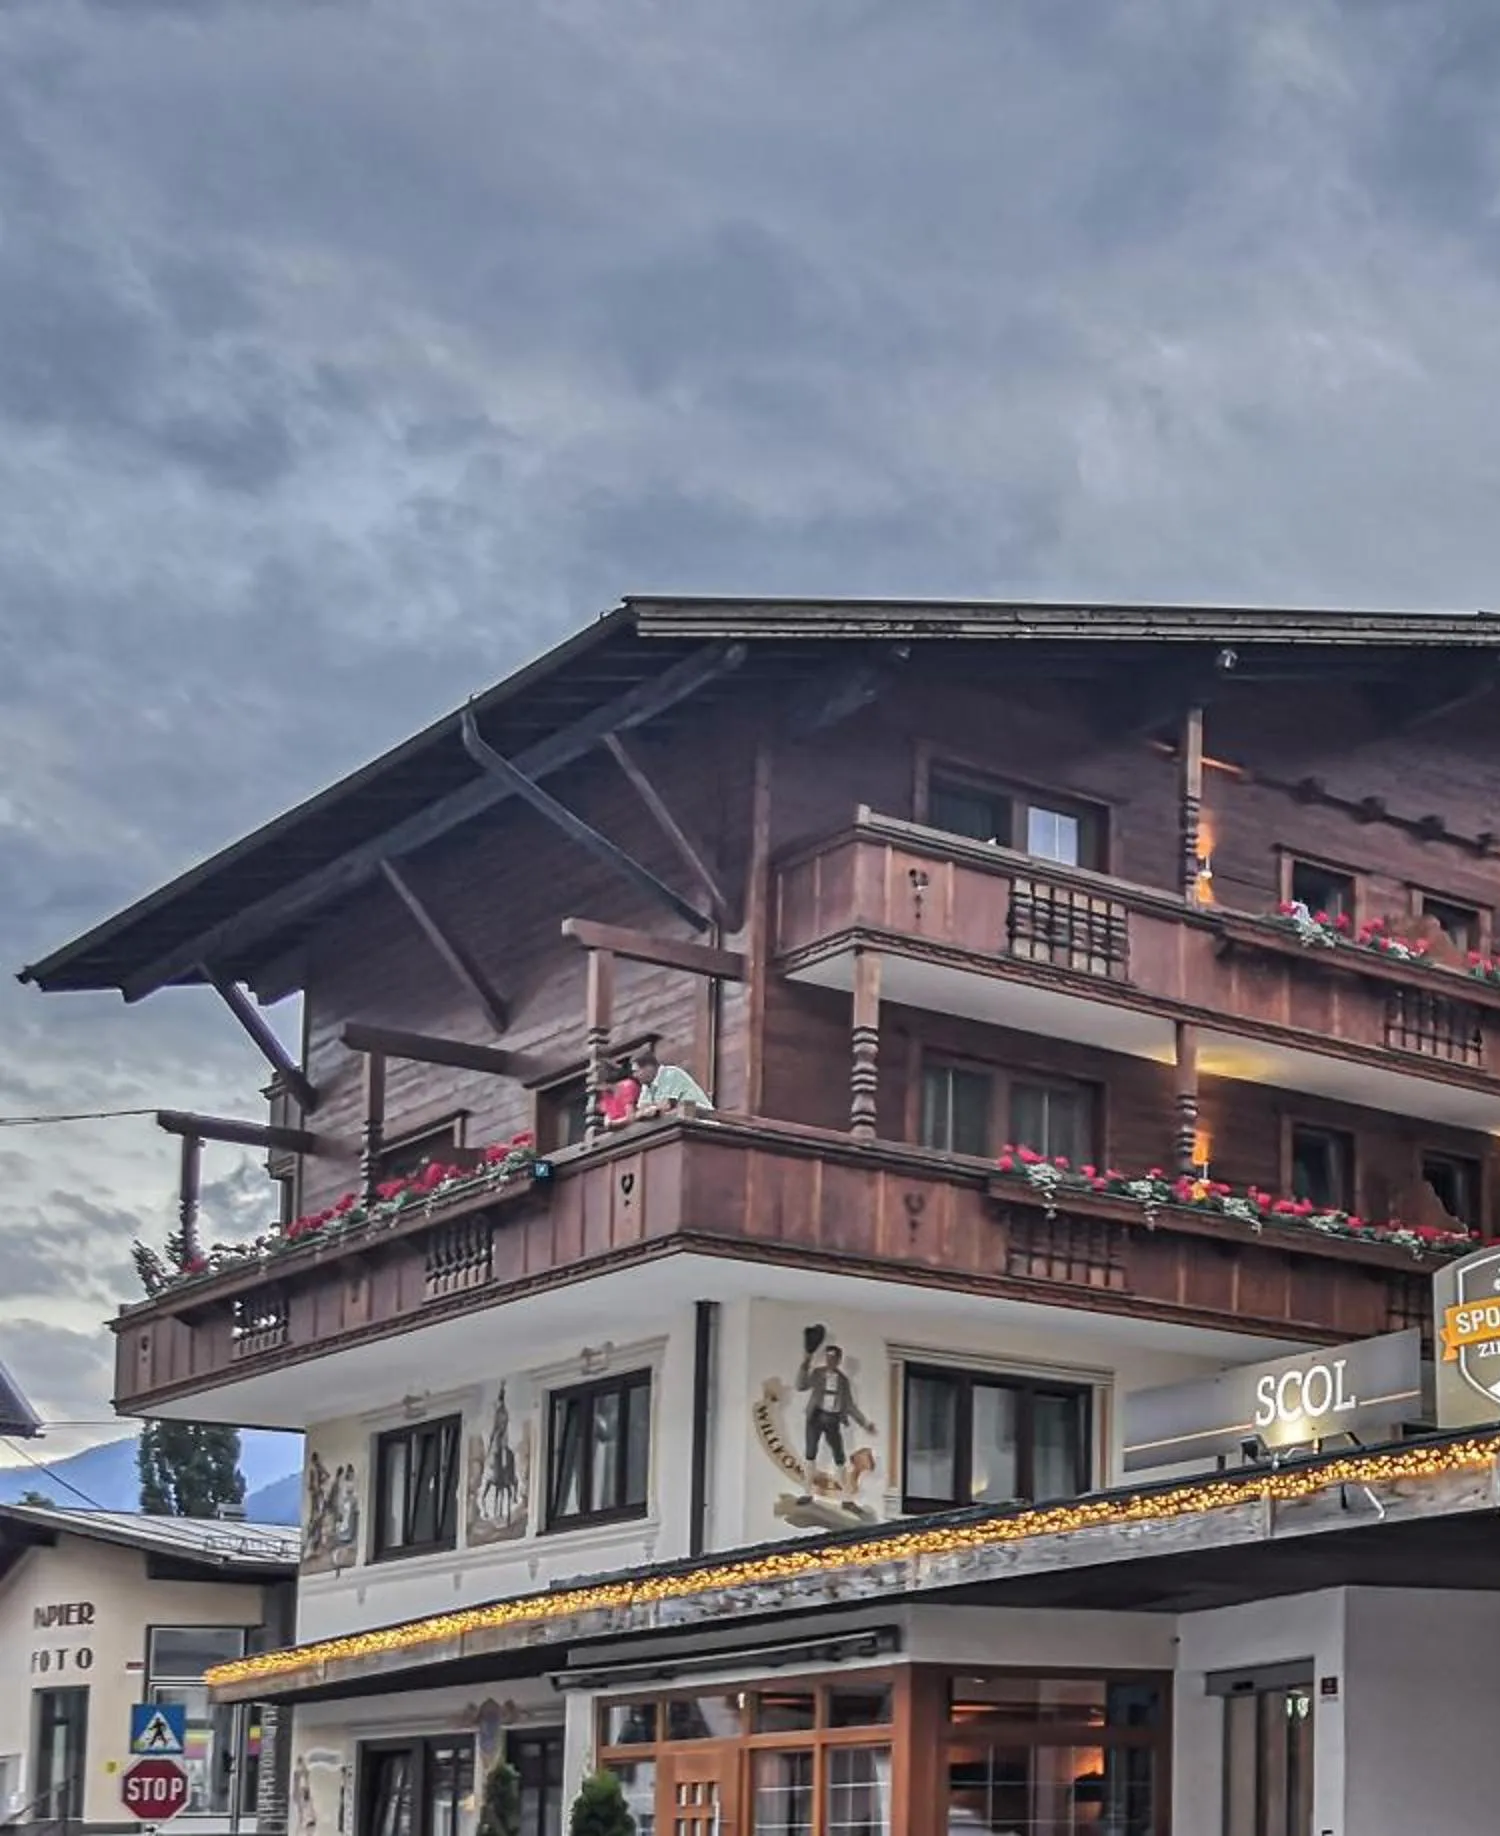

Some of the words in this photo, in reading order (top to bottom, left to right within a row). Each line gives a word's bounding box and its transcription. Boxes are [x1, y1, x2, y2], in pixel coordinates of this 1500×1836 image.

[1256, 1359, 1356, 1427] SCOL
[31, 1647, 93, 1673] FOTO
[127, 1777, 184, 1801] STOP
